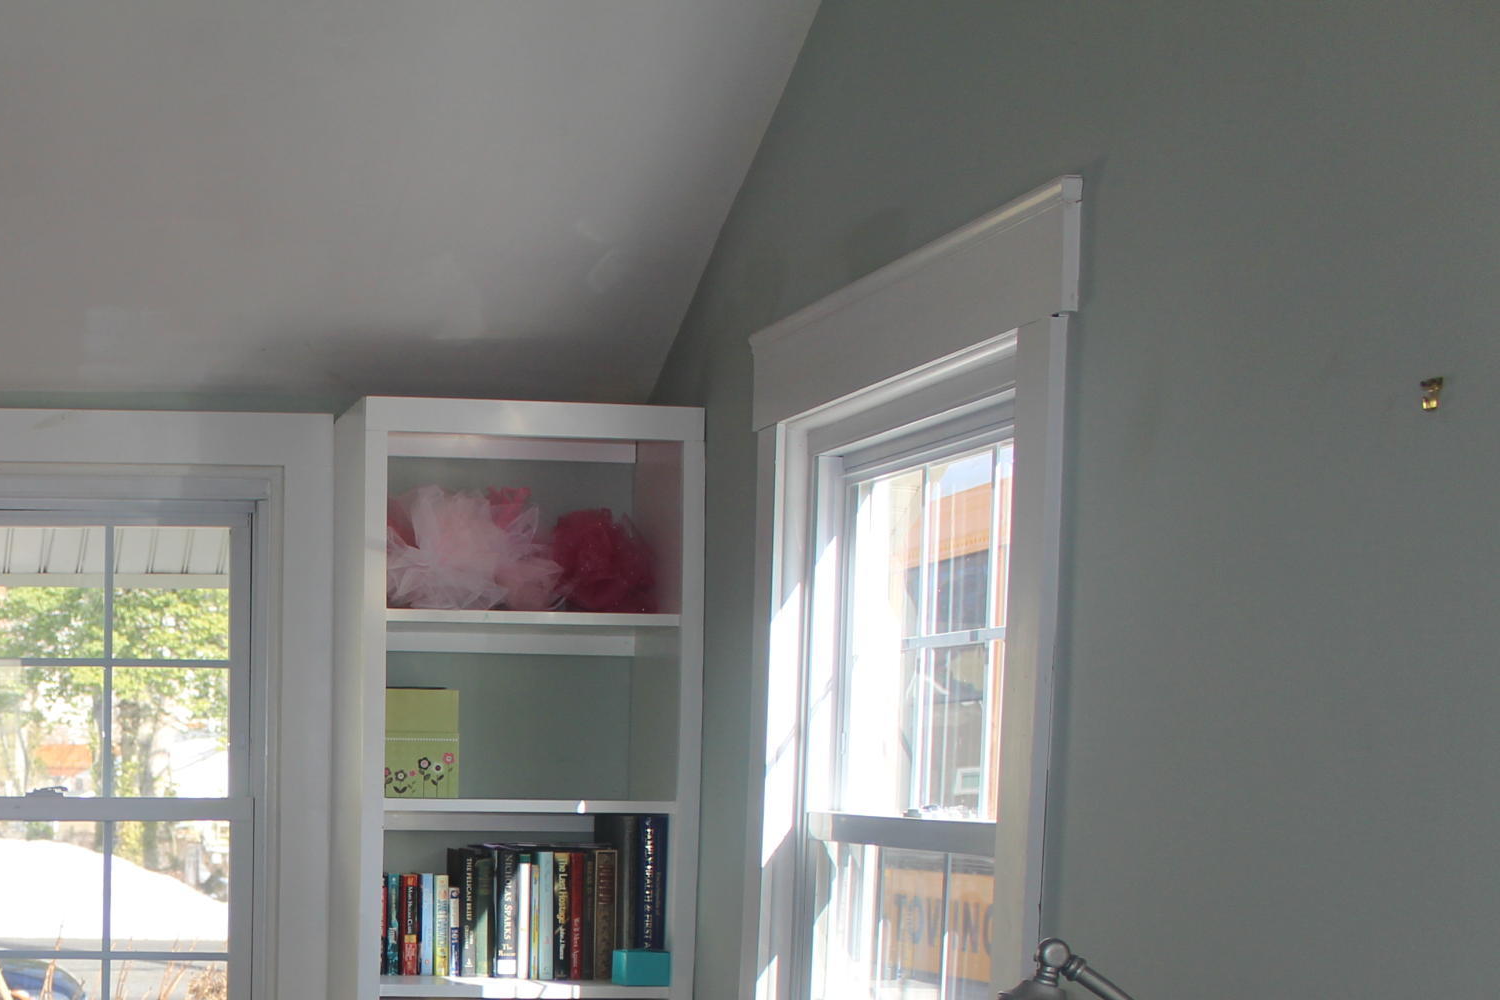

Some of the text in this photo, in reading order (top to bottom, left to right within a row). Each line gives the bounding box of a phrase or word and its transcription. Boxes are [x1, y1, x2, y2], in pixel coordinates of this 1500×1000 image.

[503, 854, 513, 940] NICHOLAS SPARKS
[557, 858, 569, 925] The Last Hostage
[644, 914, 652, 939] FIRST
